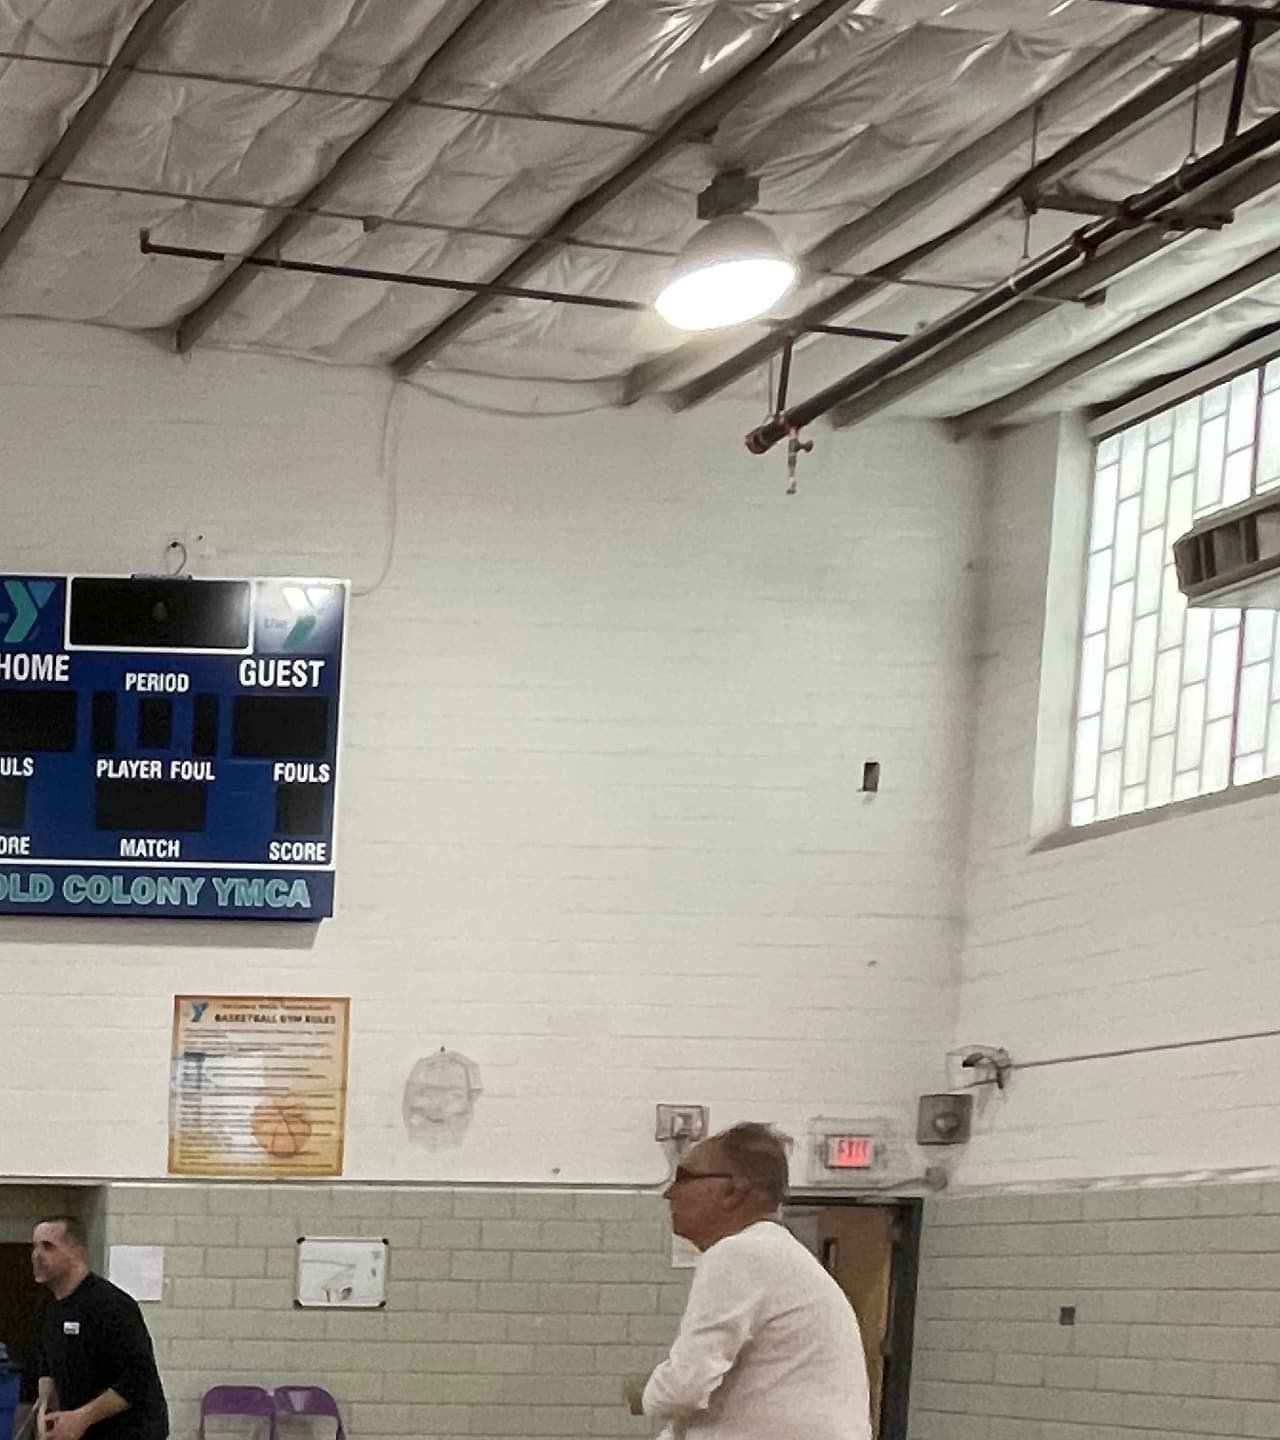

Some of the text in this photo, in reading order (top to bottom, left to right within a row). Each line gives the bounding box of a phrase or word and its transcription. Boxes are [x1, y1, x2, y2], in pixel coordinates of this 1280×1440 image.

[125, 672, 189, 693] PERIOD
[239, 658, 325, 688] GUEST
[96, 759, 216, 781] PLAYER FOUL
[273, 762, 331, 783] FOULS
[120, 838, 180, 859] MATCH
[268, 841, 327, 862] SCORE
[62, 876, 206, 905] COLONY
[212, 878, 311, 909] YMCA
[214, 1013, 277, 1023] BASKETBALL
[305, 1015, 336, 1024] RULES
